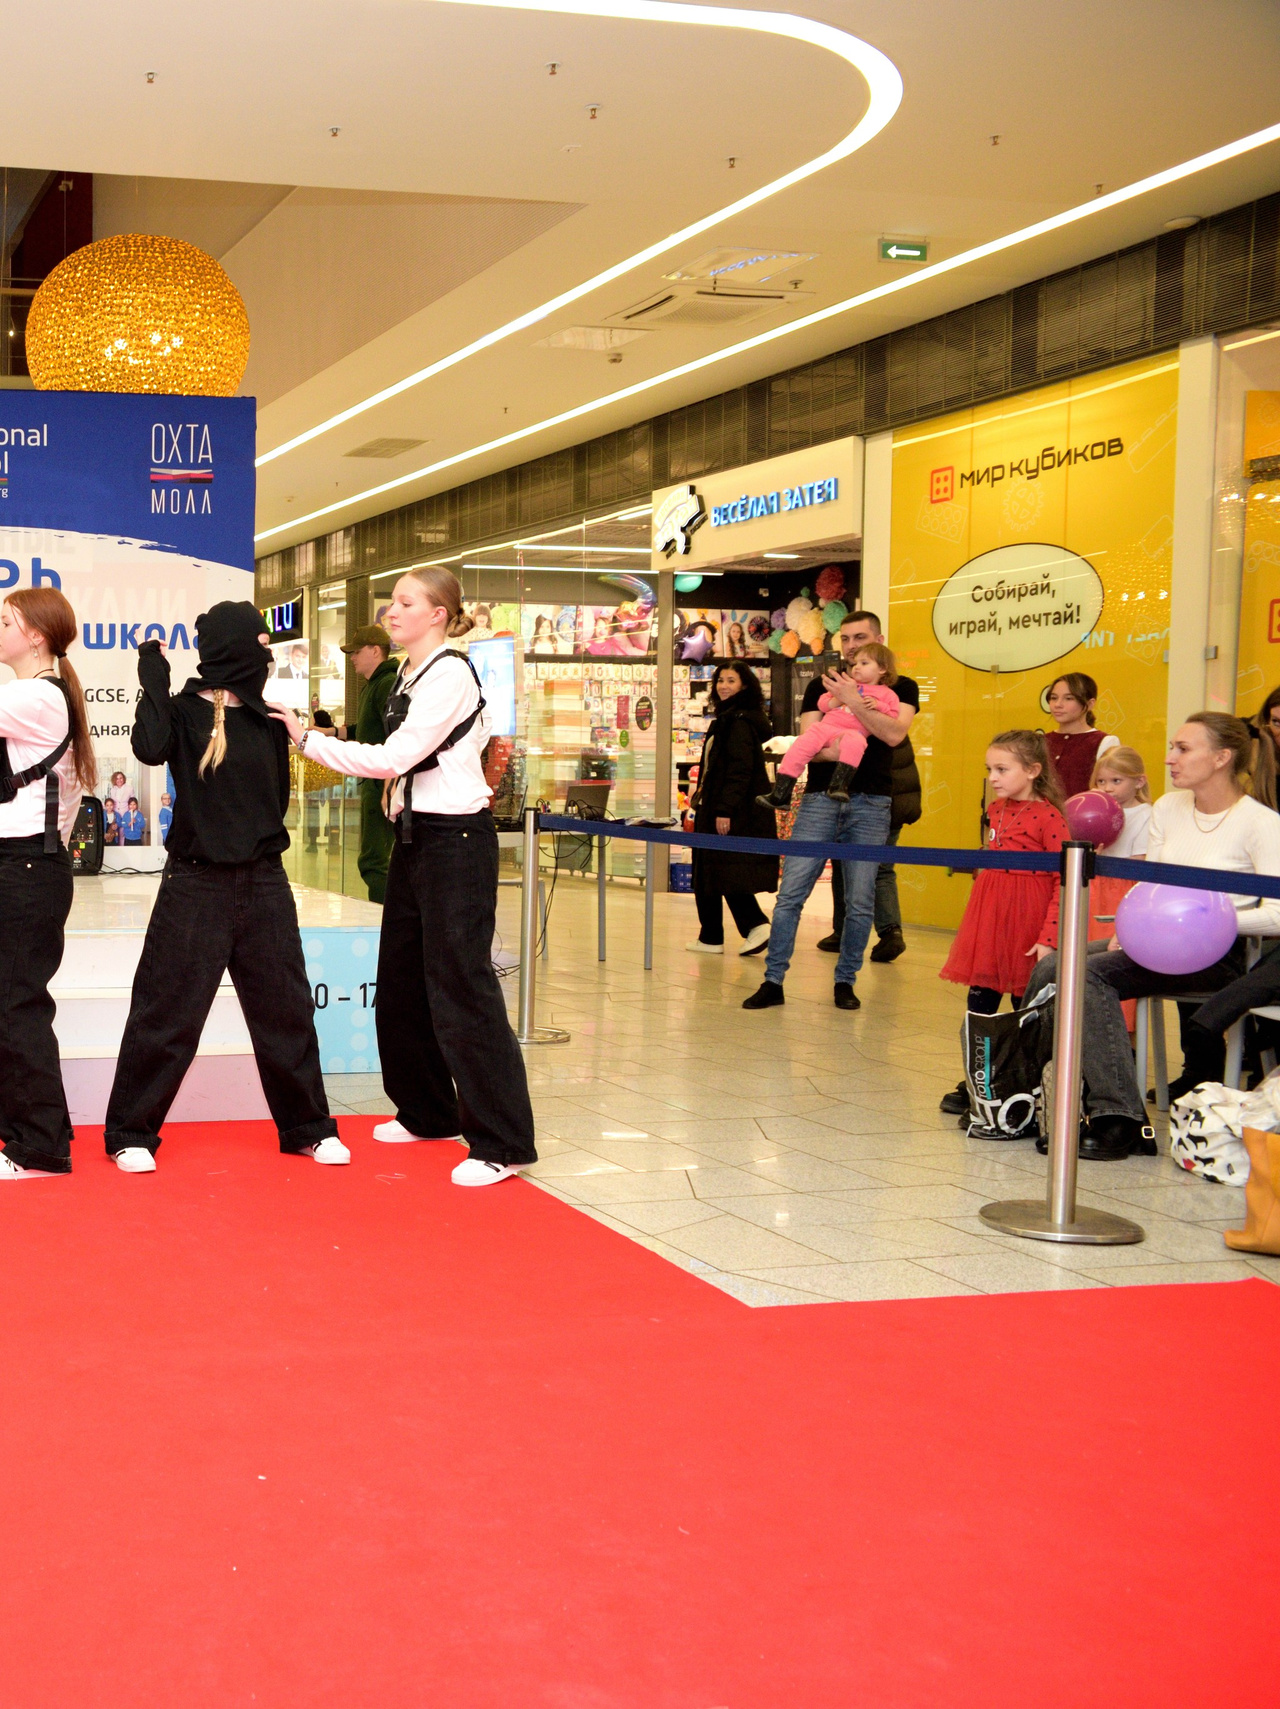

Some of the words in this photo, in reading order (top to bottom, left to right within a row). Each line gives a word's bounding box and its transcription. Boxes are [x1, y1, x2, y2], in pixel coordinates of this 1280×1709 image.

[151, 423, 213, 464] ОХТА
[960, 464, 1005, 488] мир
[1009, 437, 1124, 481] кубиков
[710, 494, 781, 528] ВЕСЁЛАЯ
[782, 476, 838, 512] ЗАТЕЯ
[971, 573, 1056, 603] Собирай,
[82, 622, 199, 651] школ
[948, 611, 1003, 639] играй,
[1008, 603, 1082, 631] мечтай!
